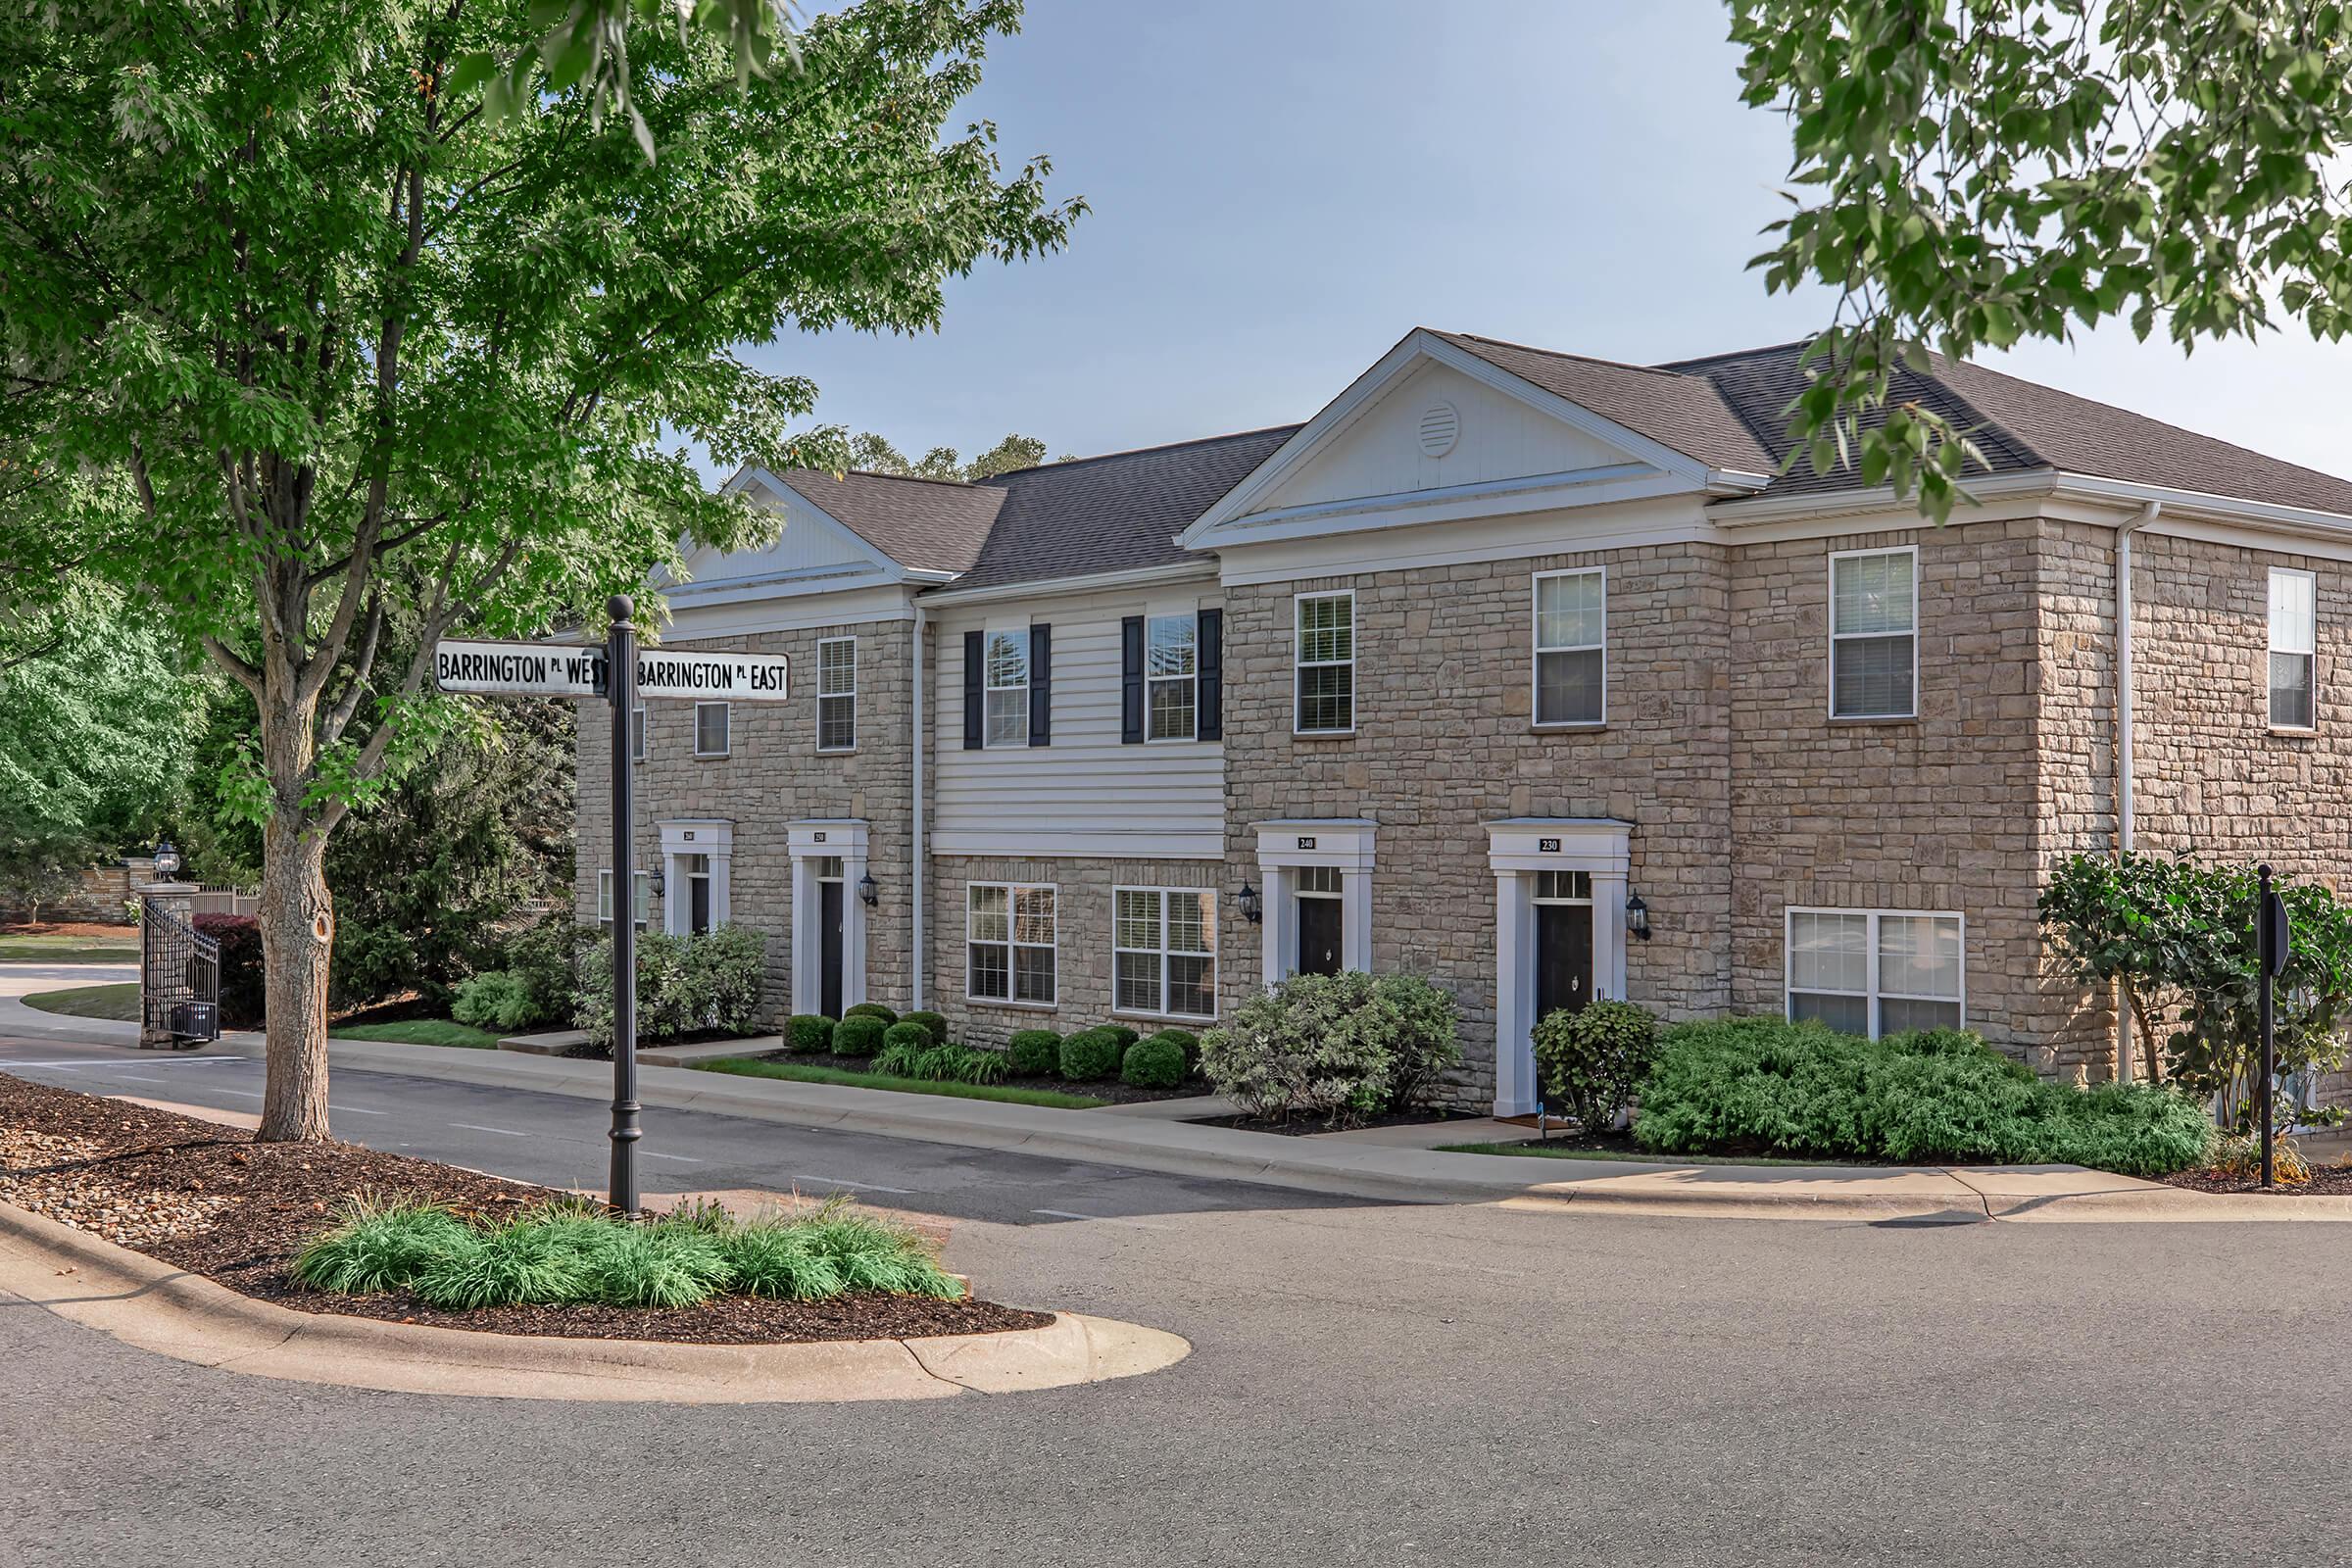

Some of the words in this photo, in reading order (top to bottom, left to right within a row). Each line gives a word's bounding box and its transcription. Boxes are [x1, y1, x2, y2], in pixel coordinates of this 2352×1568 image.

[438, 653, 547, 684] BARRINGTON
[551, 658, 563, 672] PL
[637, 661, 732, 689] BARRINGTON
[736, 664, 747, 679] PL
[751, 664, 785, 691] EAST
[1299, 838, 1313, 849] 240
[1542, 839, 1557, 851] 230
